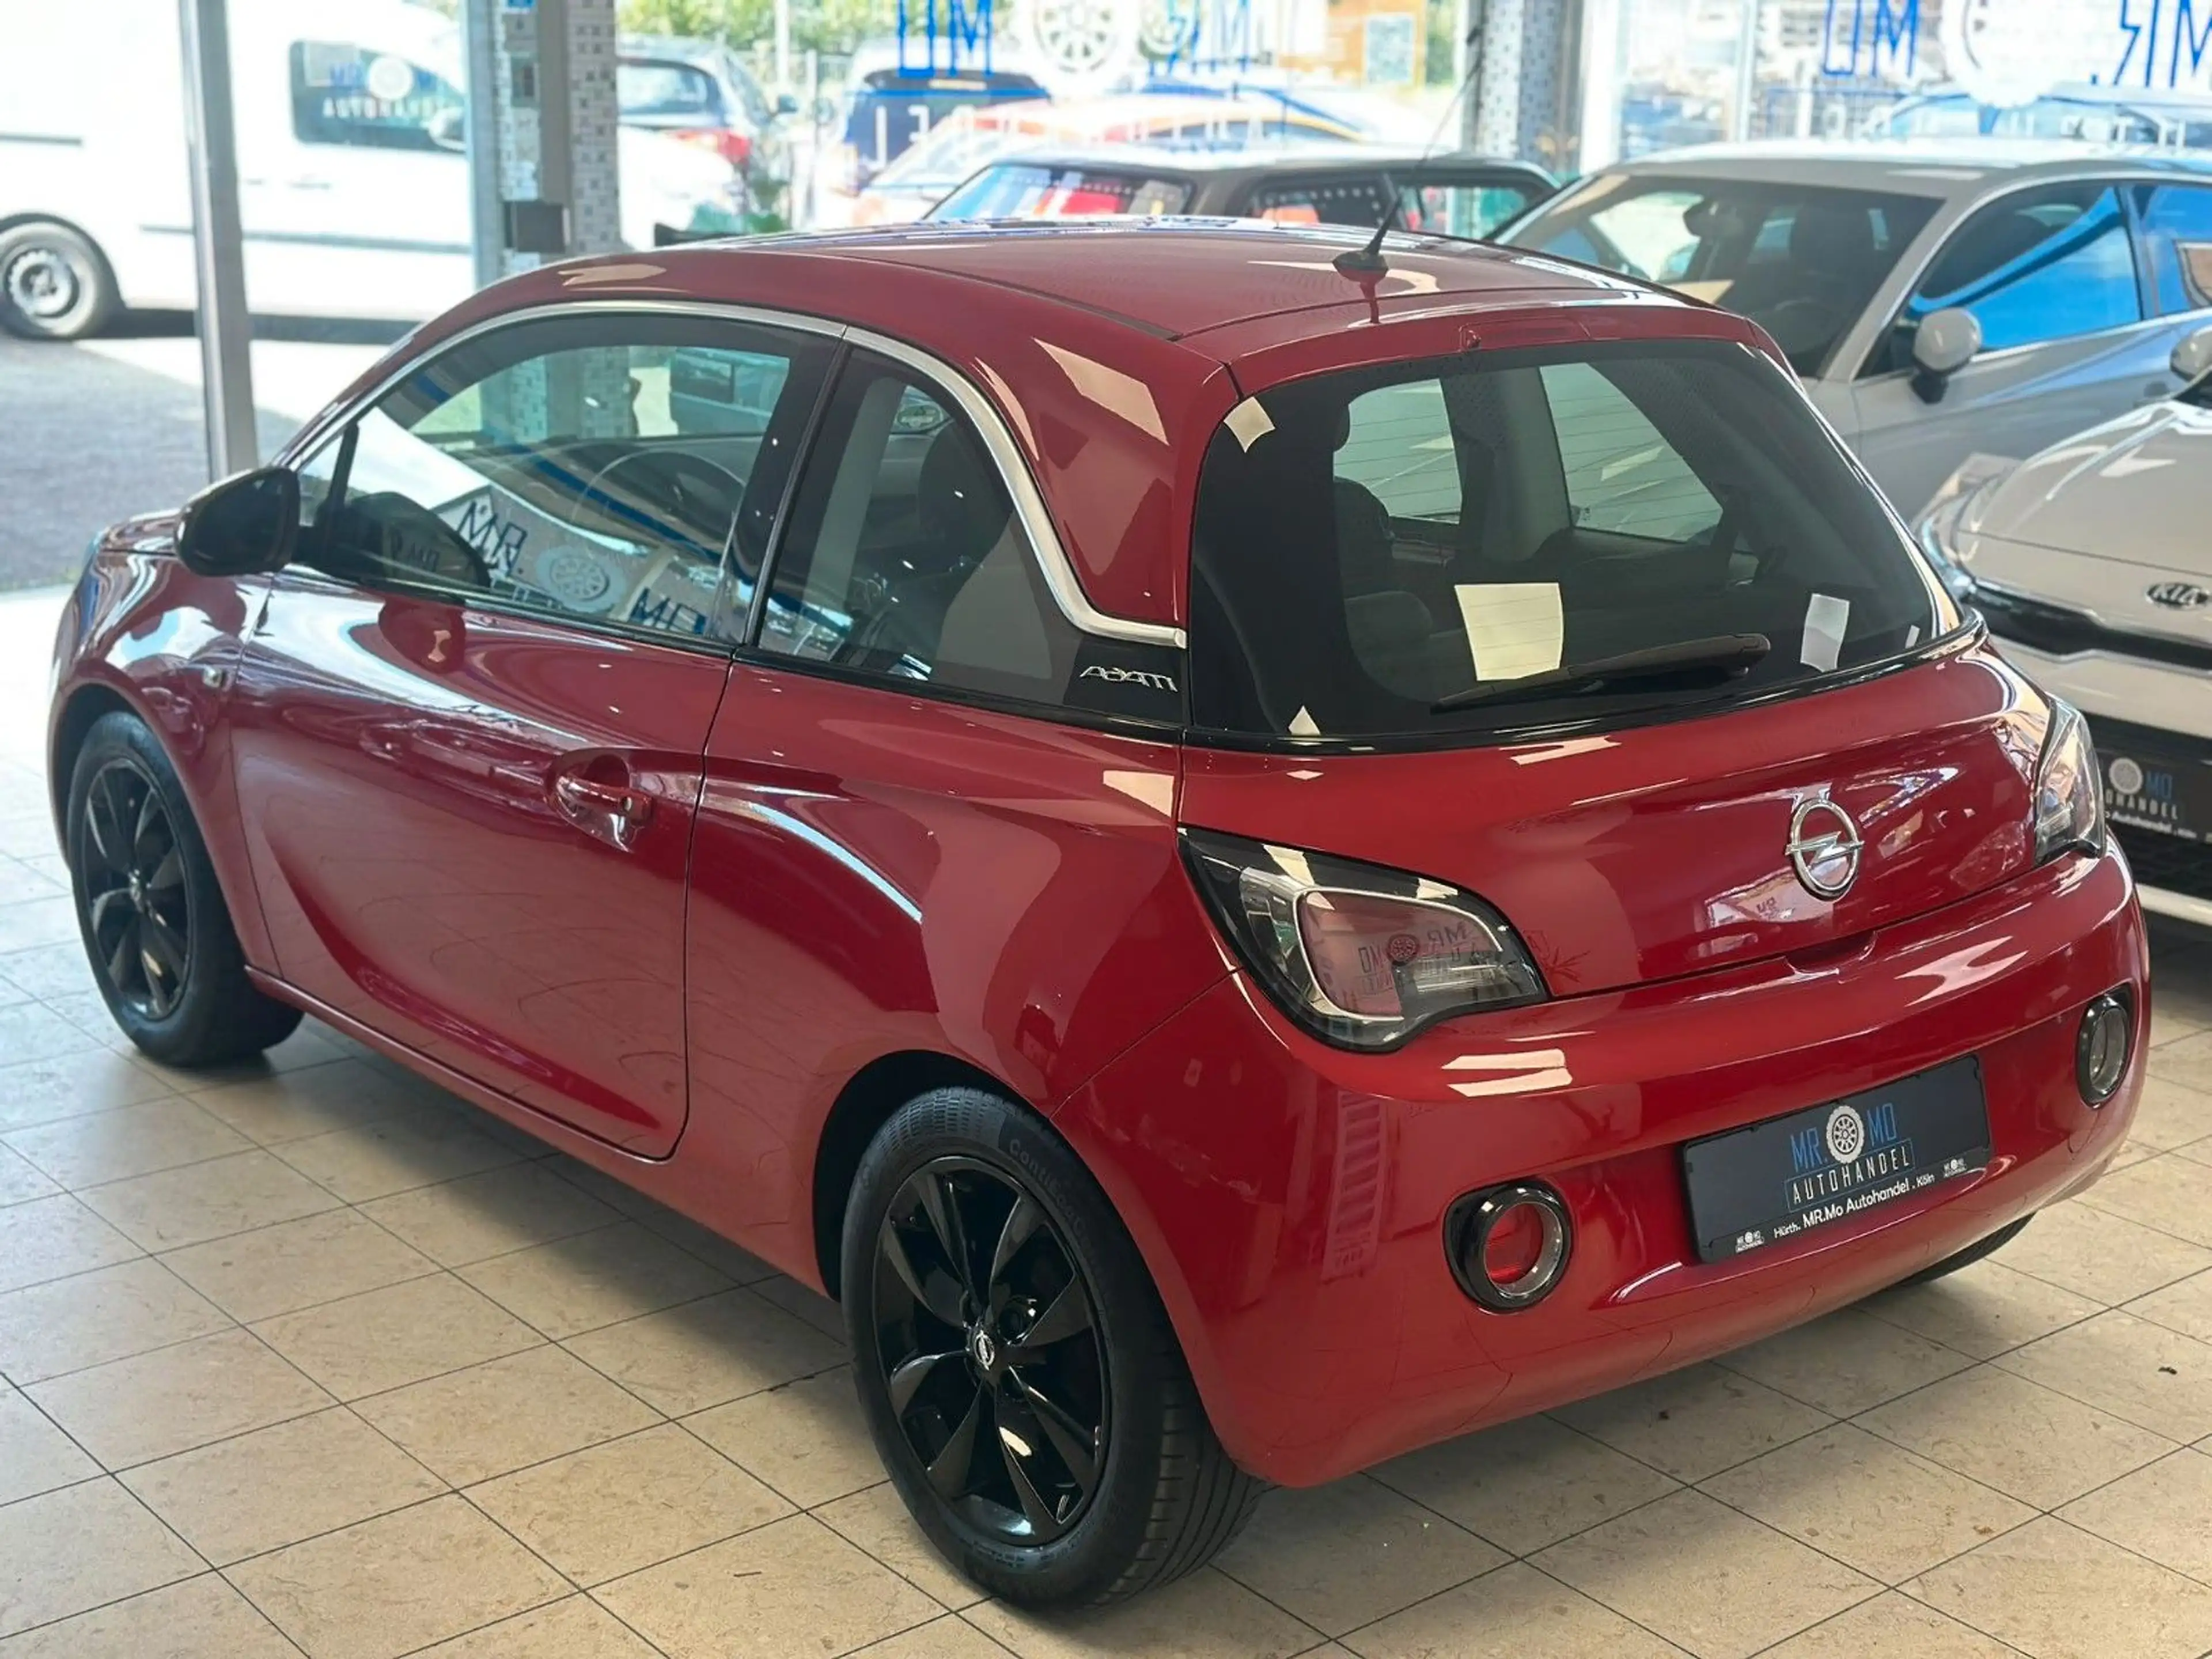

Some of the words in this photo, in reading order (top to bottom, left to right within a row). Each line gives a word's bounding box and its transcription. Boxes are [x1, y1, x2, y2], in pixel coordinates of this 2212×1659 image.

[2153, 583, 2199, 604] KIA
[2104, 788, 2178, 821] OHANDEL
[1866, 1103, 1897, 1146] MO
[1792, 1145, 1910, 1206] AUTOHANDEL
[1802, 1203, 1844, 1229] MR.Mo
[1846, 1177, 1910, 1214] Autohandel
